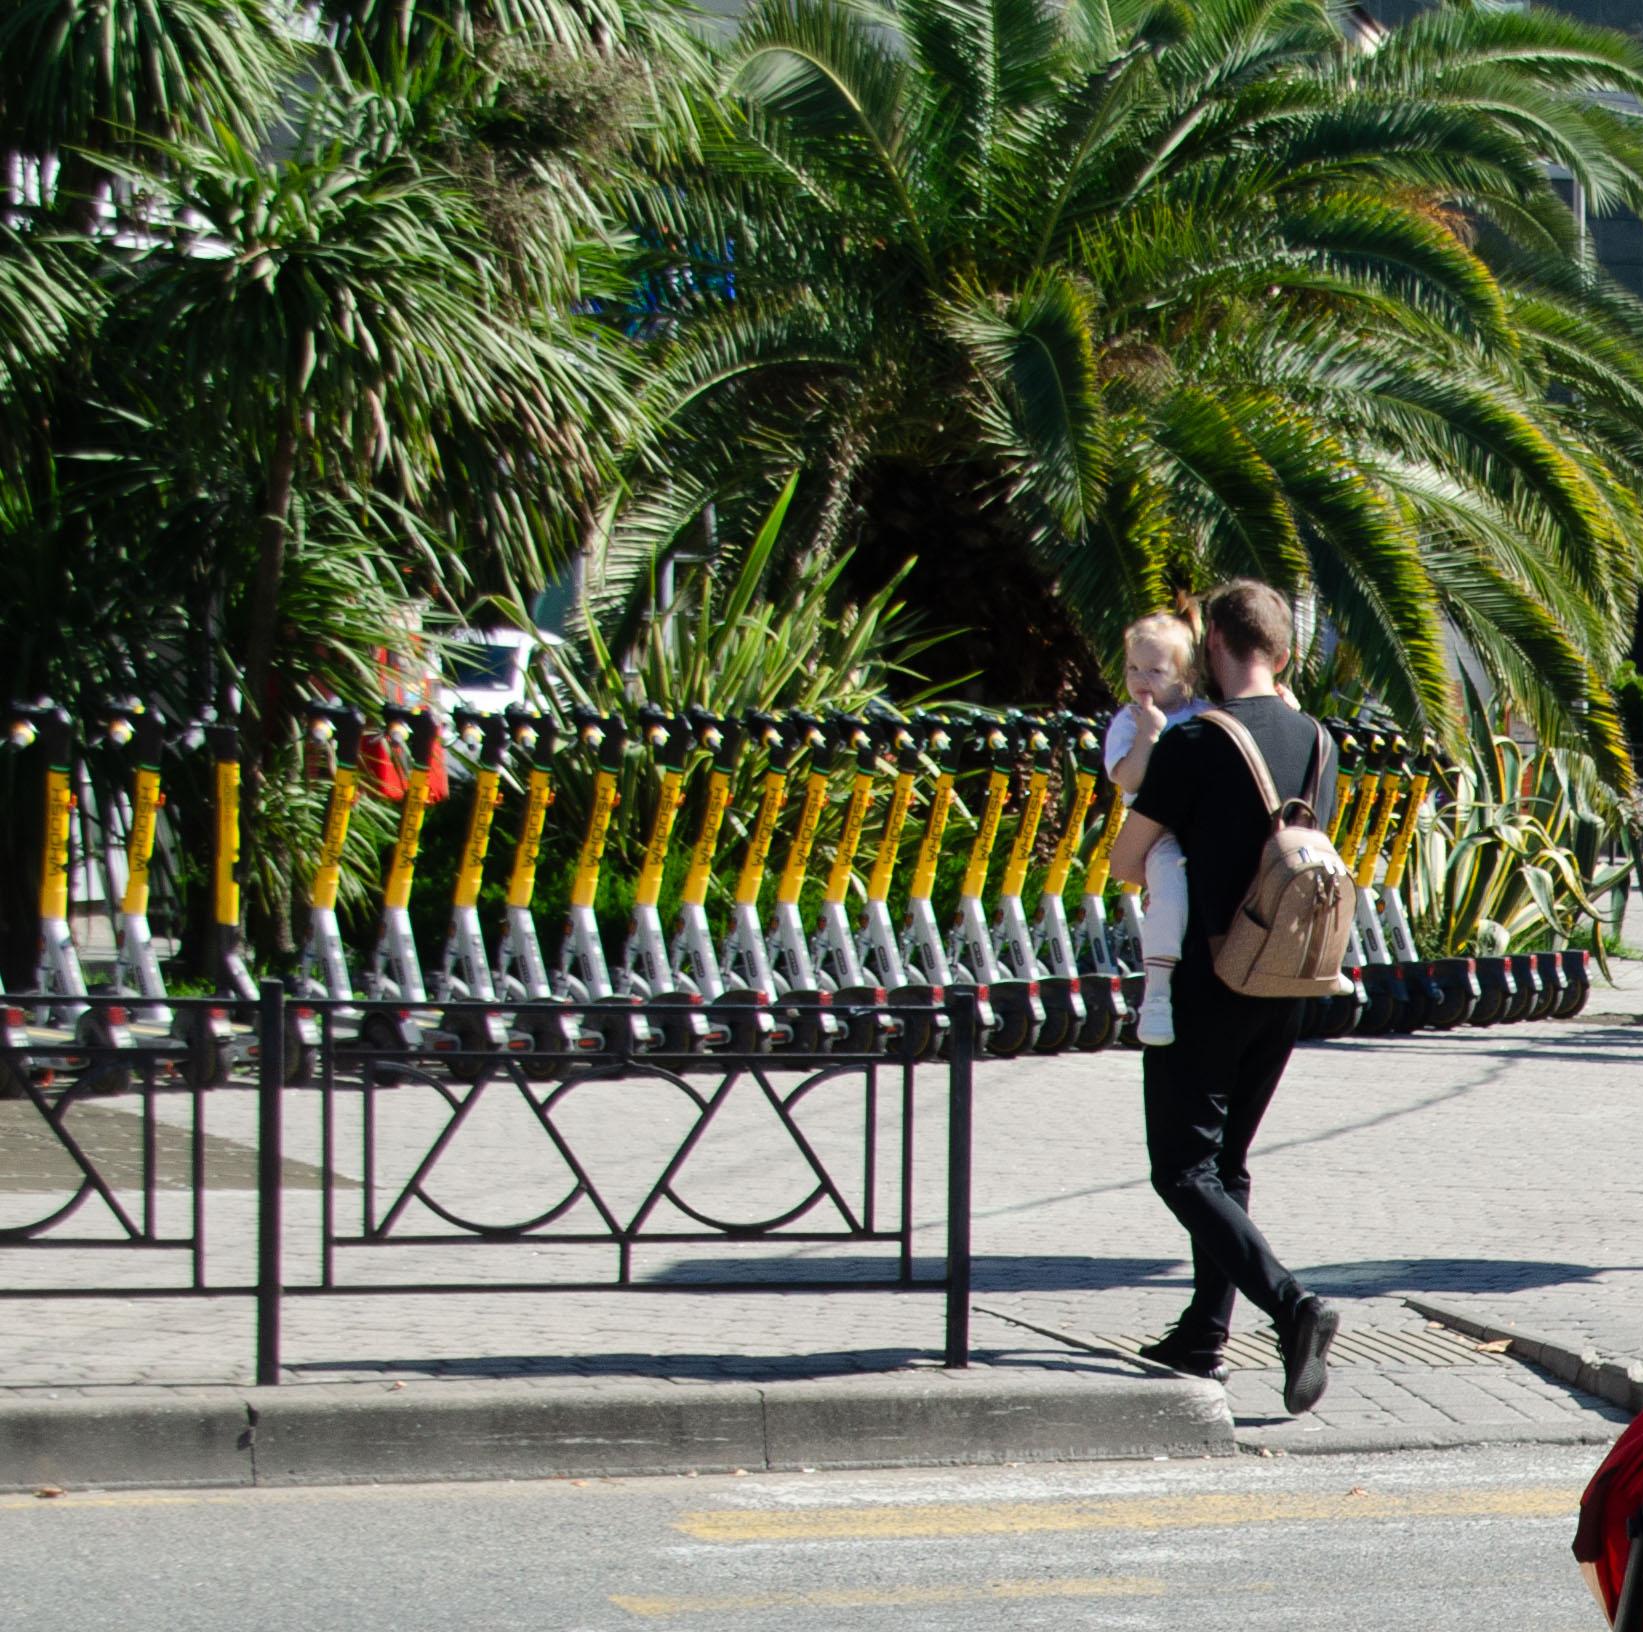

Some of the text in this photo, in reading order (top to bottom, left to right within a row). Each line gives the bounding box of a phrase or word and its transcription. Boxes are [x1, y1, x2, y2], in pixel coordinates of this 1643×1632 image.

[651, 786, 676, 865] WHOOSH
[700, 788, 724, 866] WHOOSH
[978, 787, 1003, 861] WHOOSH
[1017, 786, 1045, 860] WHOOSH
